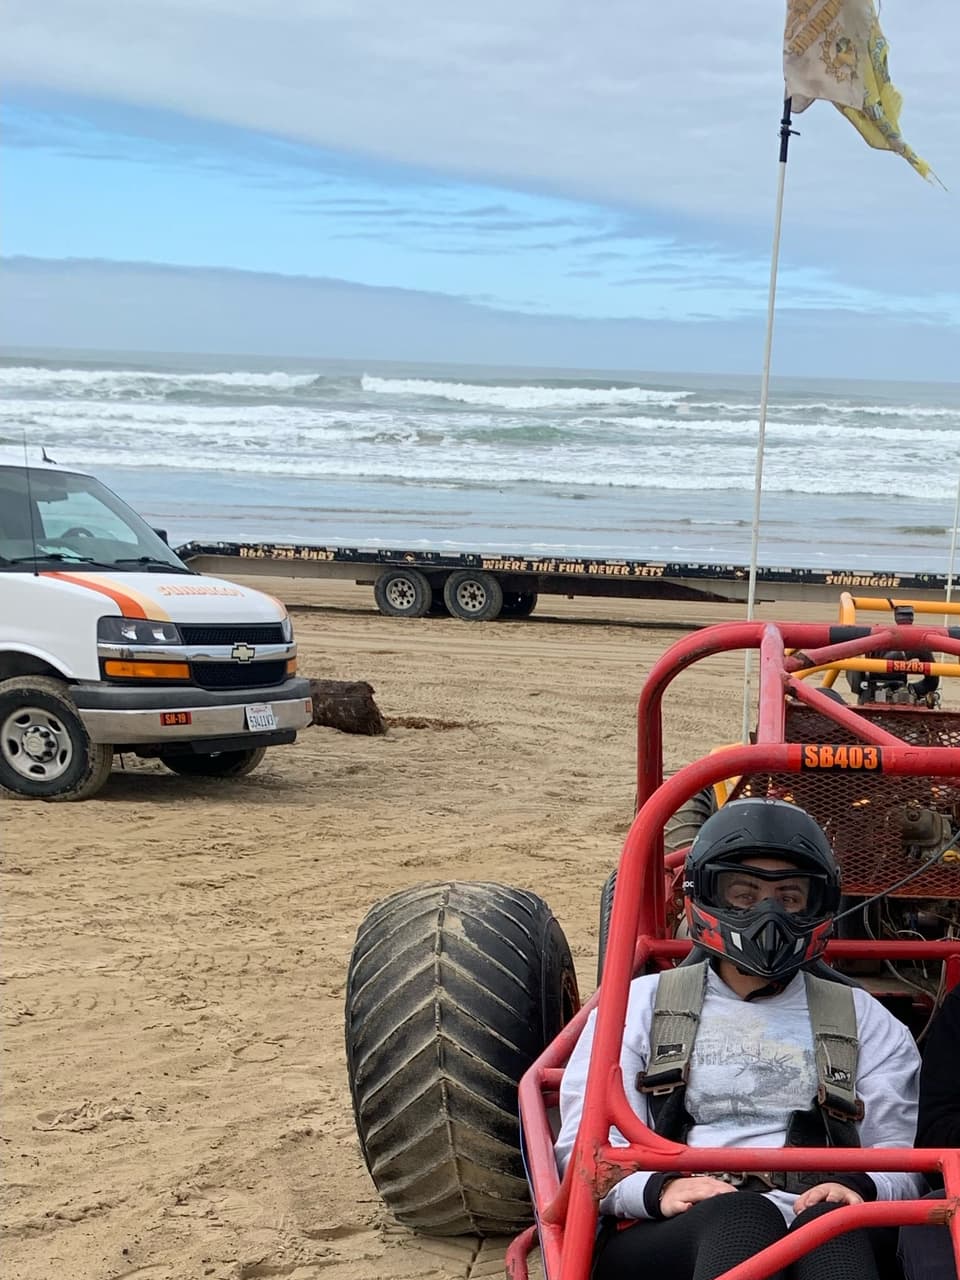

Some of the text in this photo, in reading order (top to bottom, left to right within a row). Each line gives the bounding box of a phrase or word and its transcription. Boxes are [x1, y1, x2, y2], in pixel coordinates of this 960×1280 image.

[482, 560, 664, 576] WHERE THE FUN NEVER SETS
[825, 575, 901, 587] SUNBUGGIE
[893, 662, 924, 672] SB203
[804, 746, 878, 769] SB403
